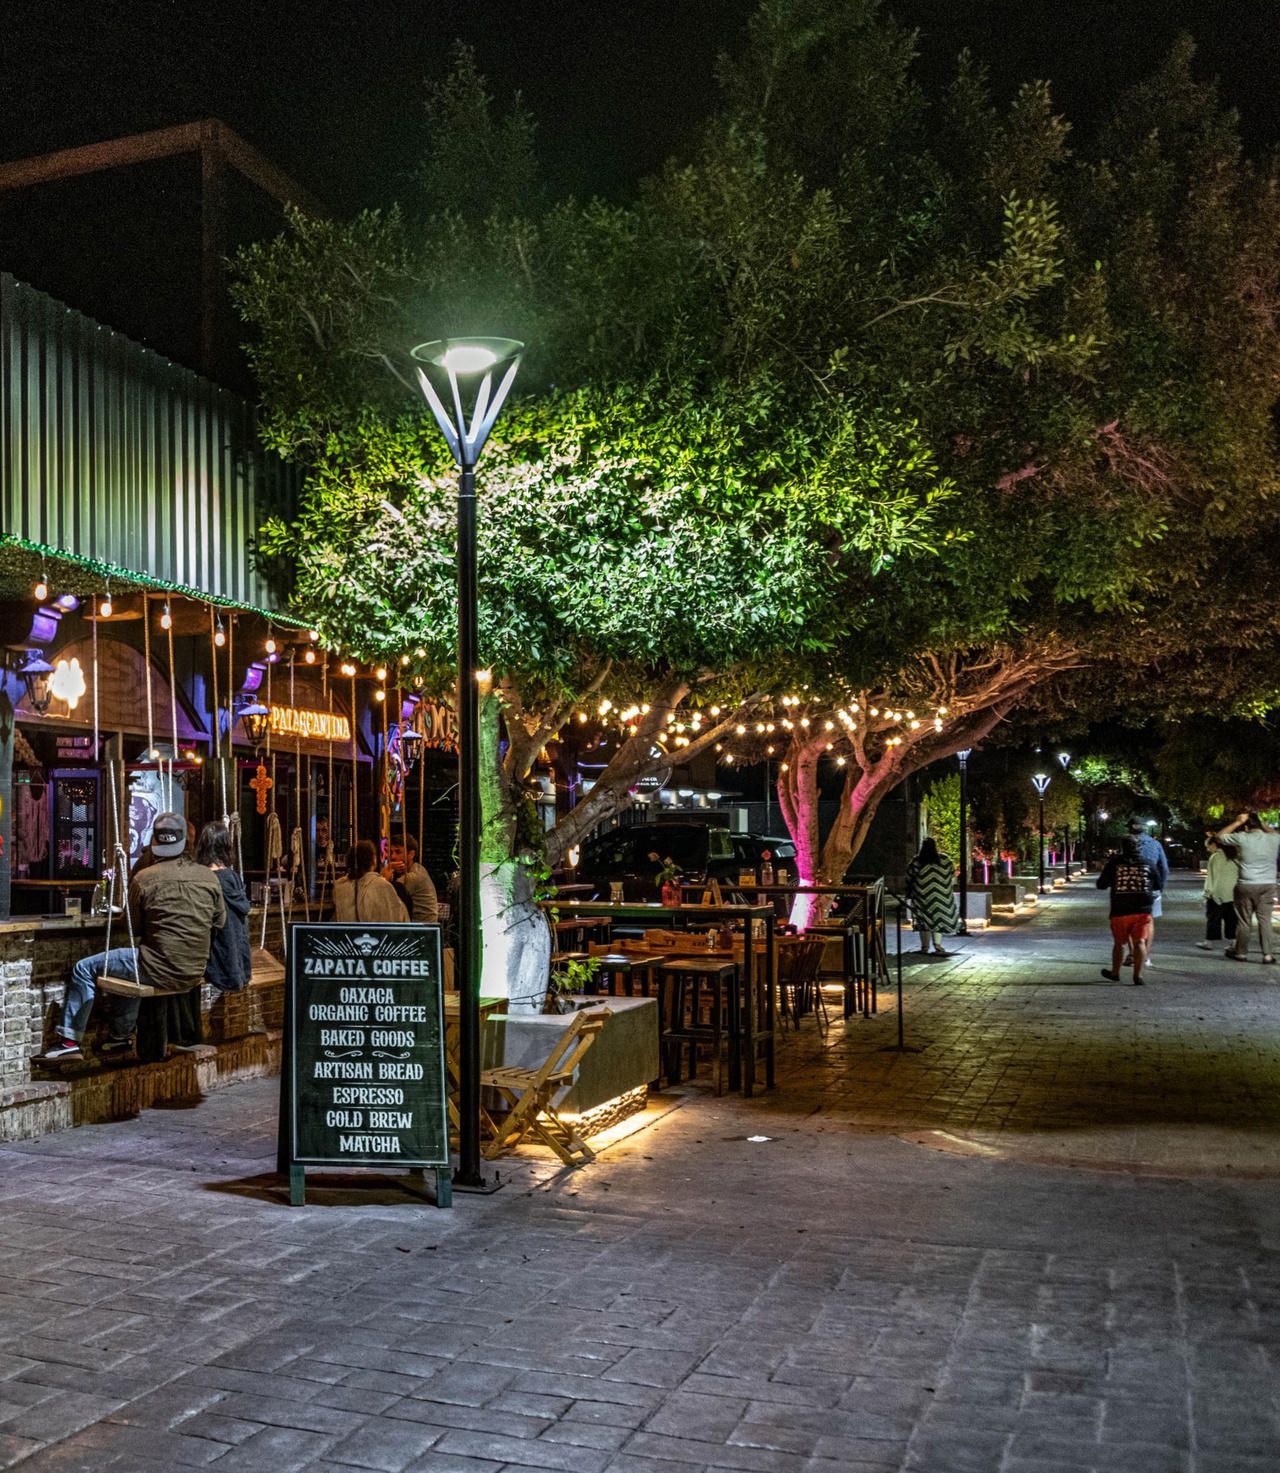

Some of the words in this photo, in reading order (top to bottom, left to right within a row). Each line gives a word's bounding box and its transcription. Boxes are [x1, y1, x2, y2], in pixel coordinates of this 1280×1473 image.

[305, 959, 367, 975] ZAPATA
[373, 960, 429, 976] COFFEE
[340, 987, 395, 1005] OAXACA
[309, 1005, 369, 1022] ORGANIC
[375, 1006, 427, 1023] COFFEE
[320, 1030, 365, 1046] BAKED
[371, 1031, 415, 1047] GOODS
[314, 1062, 373, 1079] ARTISAN
[379, 1063, 424, 1080] BREAD
[333, 1087, 404, 1105] ESPRESSO
[326, 1111, 363, 1128] COLD
[370, 1112, 413, 1129] BREW
[339, 1135, 401, 1153] MATCHA
